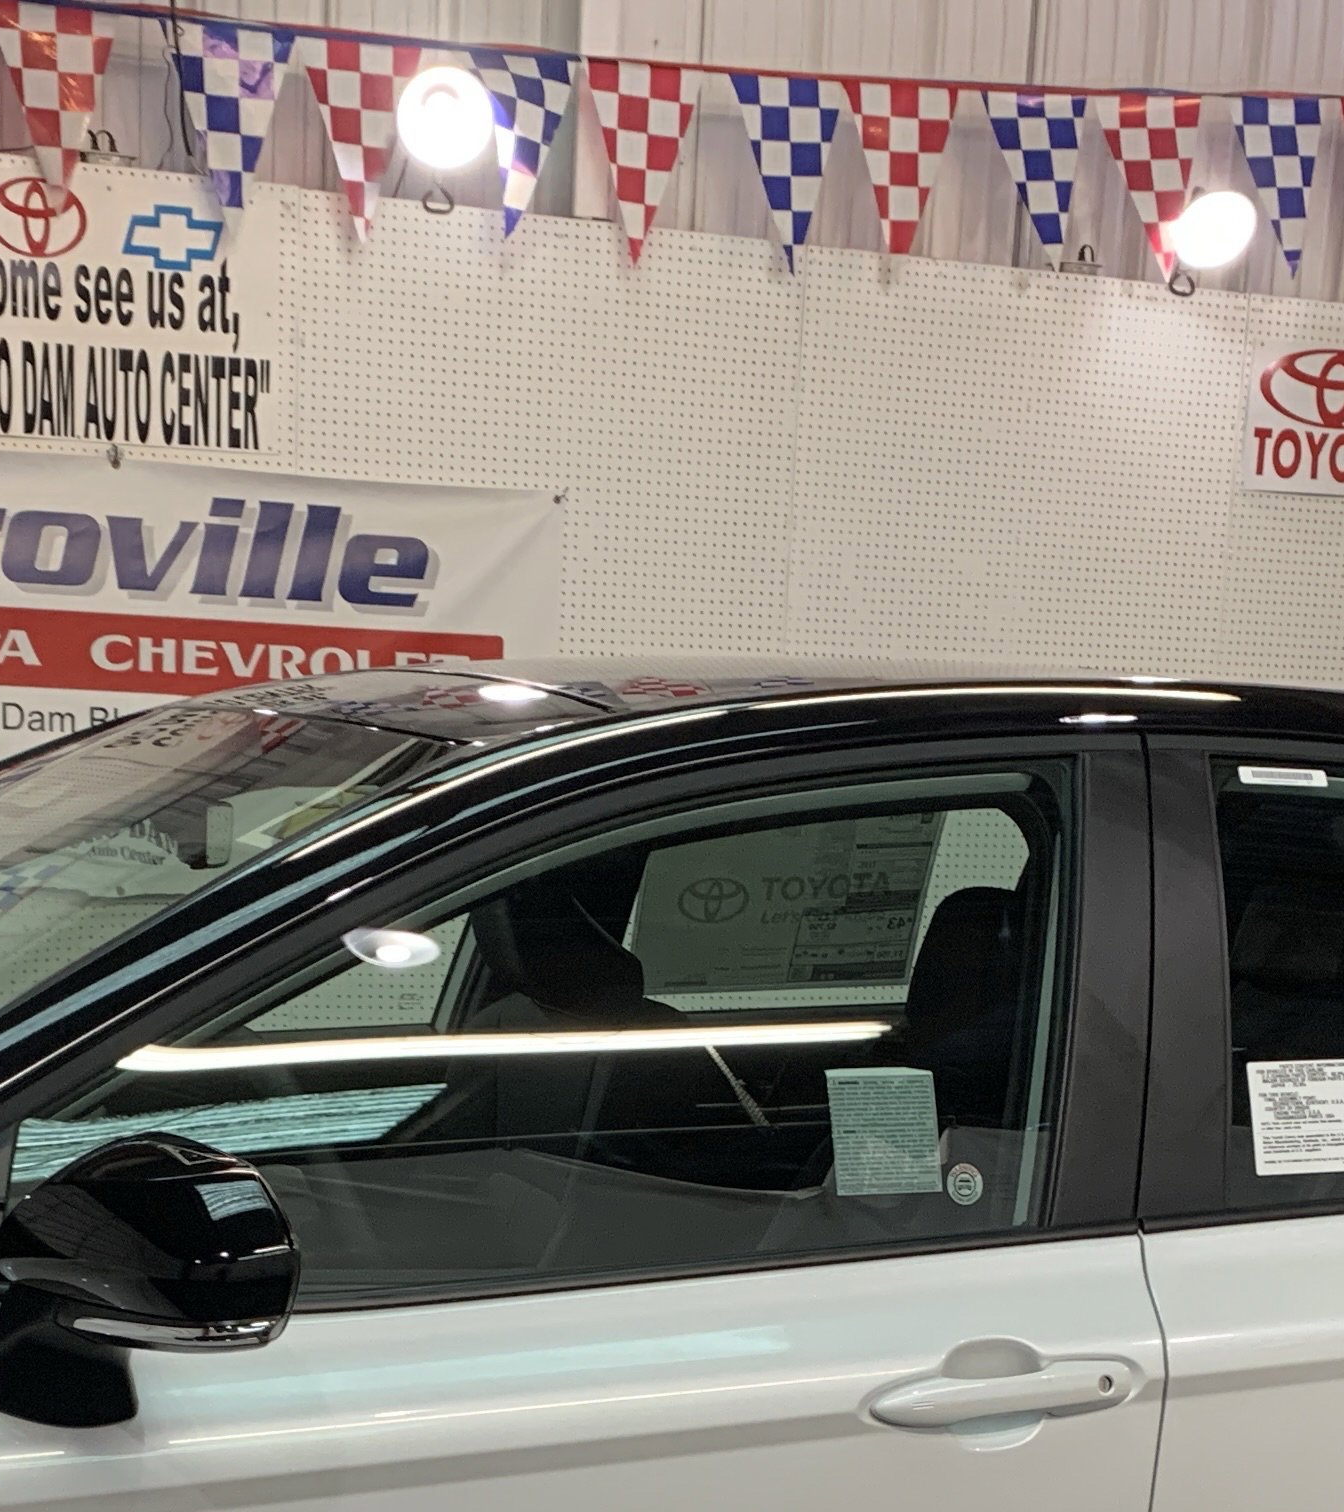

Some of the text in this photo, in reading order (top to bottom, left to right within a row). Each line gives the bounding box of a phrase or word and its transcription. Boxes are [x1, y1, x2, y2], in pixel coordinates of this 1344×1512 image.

[74, 263, 134, 326] see
[147, 270, 185, 331] us
[198, 258, 240, 352] at,
[22, 340, 76, 437] DAM
[84, 345, 151, 444] AUTO
[160, 351, 271, 450] CENTER"
[90, 633, 470, 682] CHEVRO
[0, 700, 78, 734] Dam
